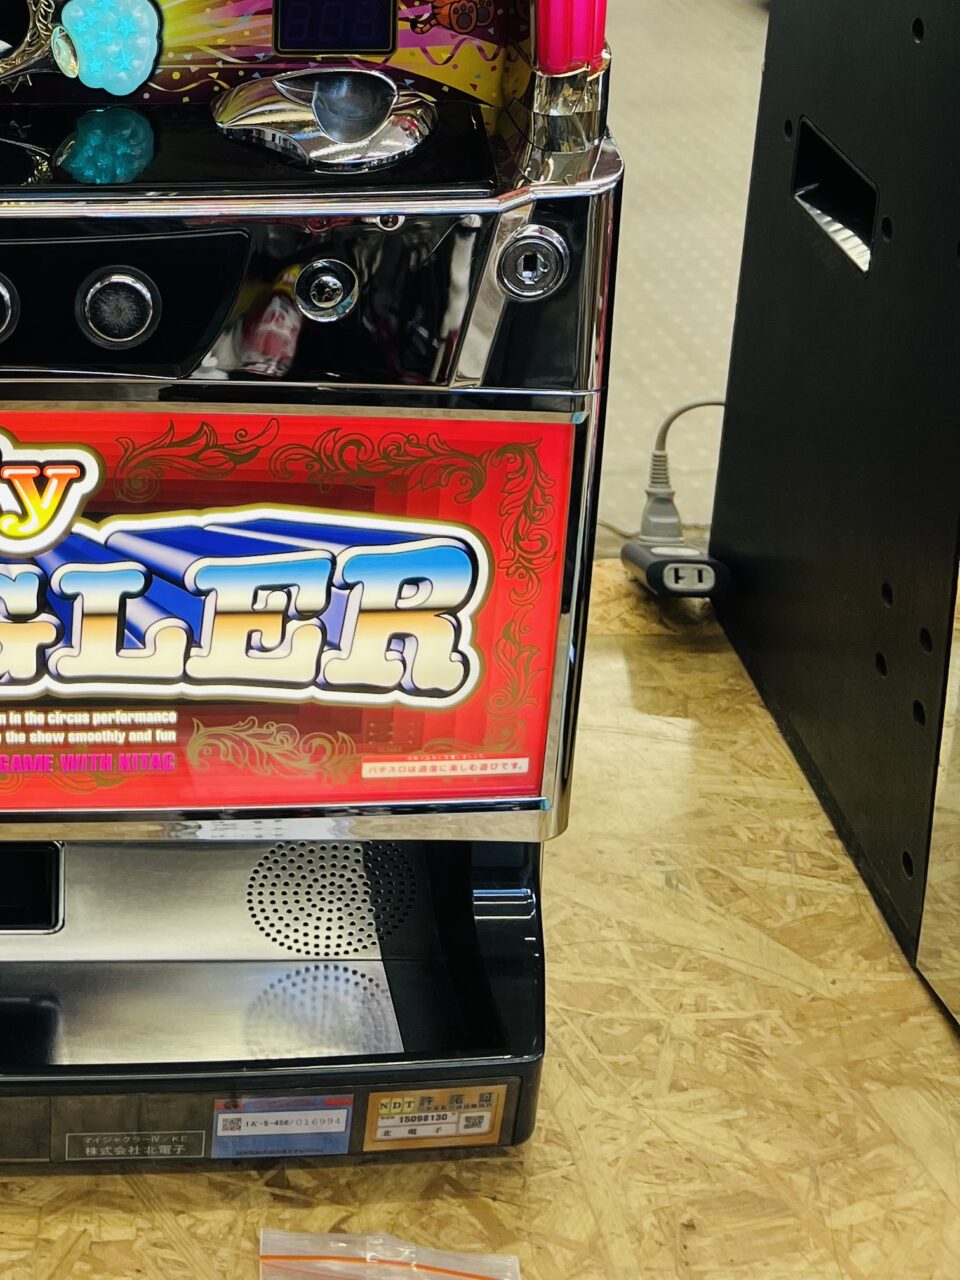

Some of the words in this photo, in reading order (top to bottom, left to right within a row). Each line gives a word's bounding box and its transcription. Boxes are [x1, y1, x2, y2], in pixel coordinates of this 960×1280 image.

[9, 710, 22, 725] in
[24, 710, 45, 725] the
[47, 710, 90, 725] circus
[92, 709, 177, 727] performance
[5, 730, 26, 744] the
[29, 730, 65, 744] show
[68, 729, 126, 745] smoothly
[128, 729, 153, 743] and
[155, 728, 177, 743] fun
[60, 753, 113, 773] WITH
[118, 752, 176, 772] KITAC
[85, 1144, 186, 1157] 株式会社北電子
